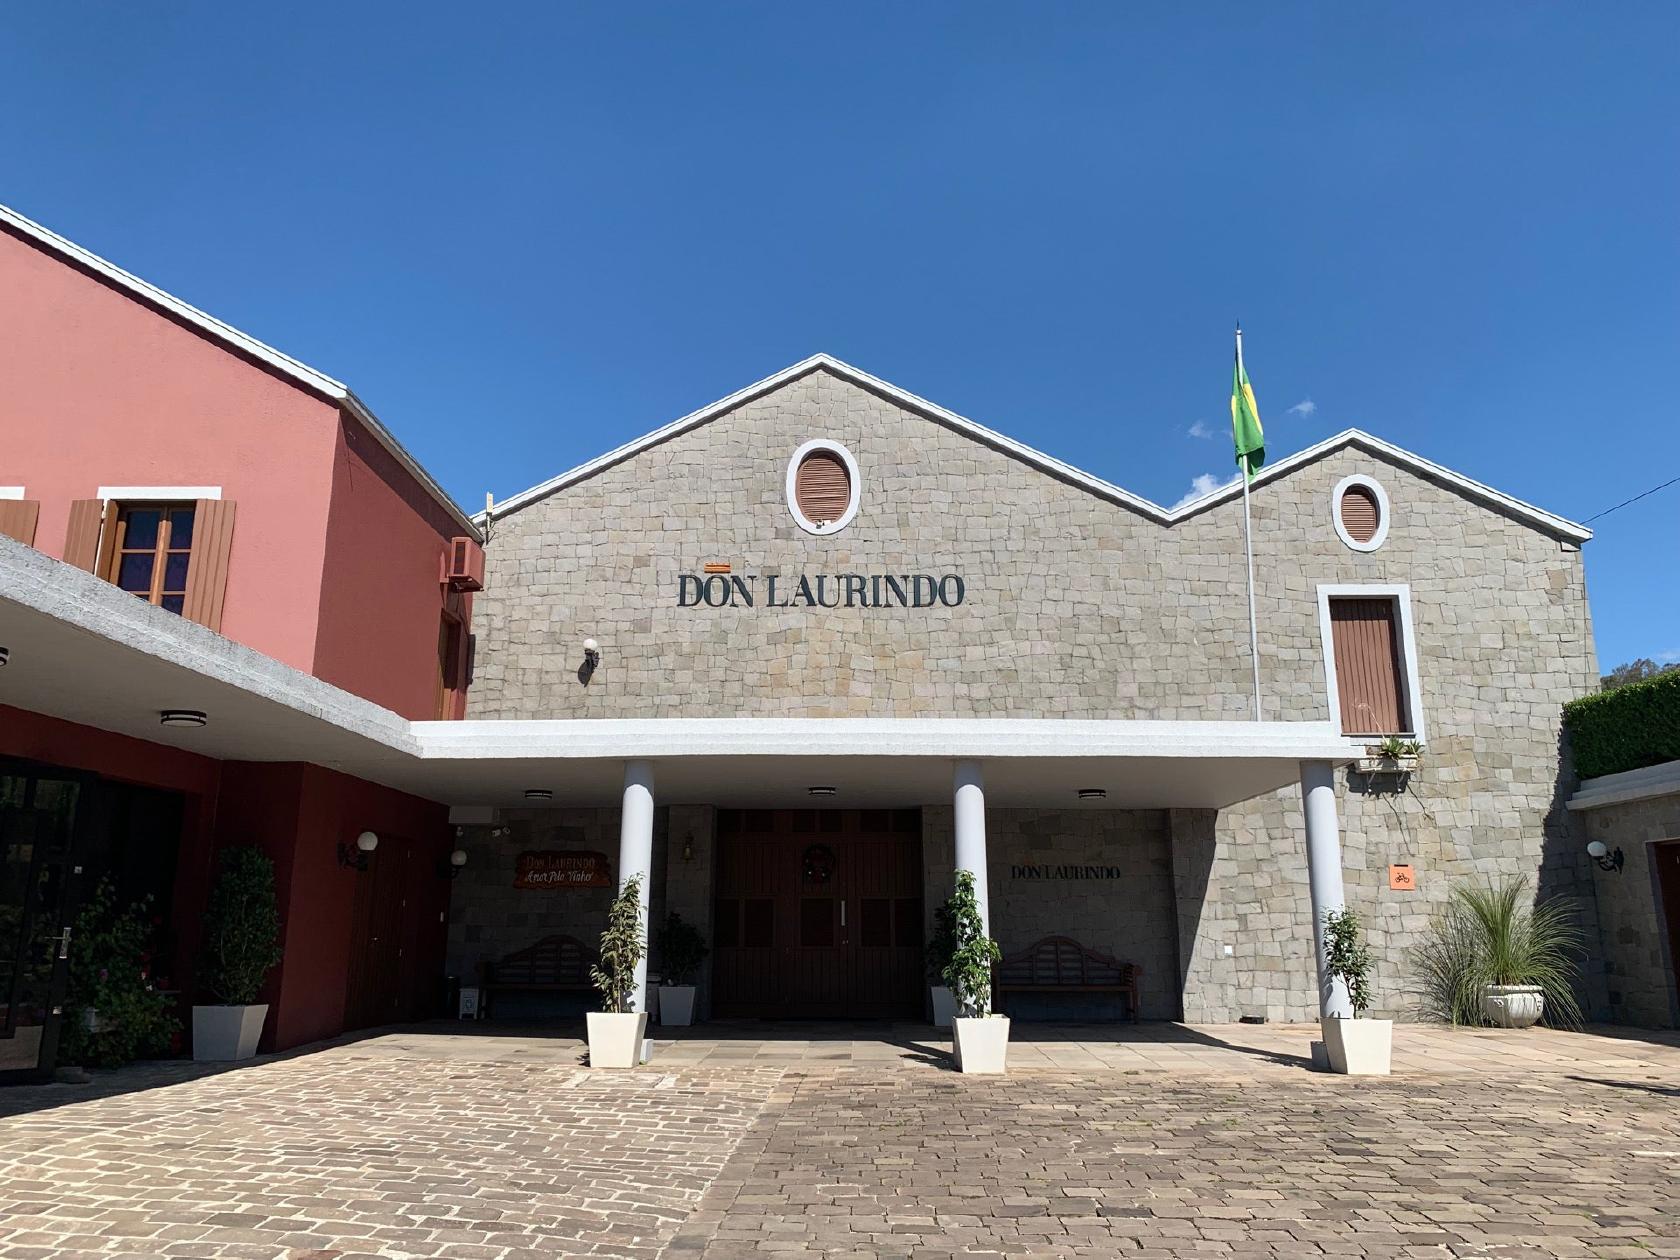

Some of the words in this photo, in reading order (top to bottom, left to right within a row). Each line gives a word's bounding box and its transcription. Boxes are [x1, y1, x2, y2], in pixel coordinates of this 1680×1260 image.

[677, 574, 757, 608] DON
[766, 574, 965, 608] LAURINDO
[1011, 865, 1041, 880] DON
[1044, 865, 1121, 880] LAURINDO
